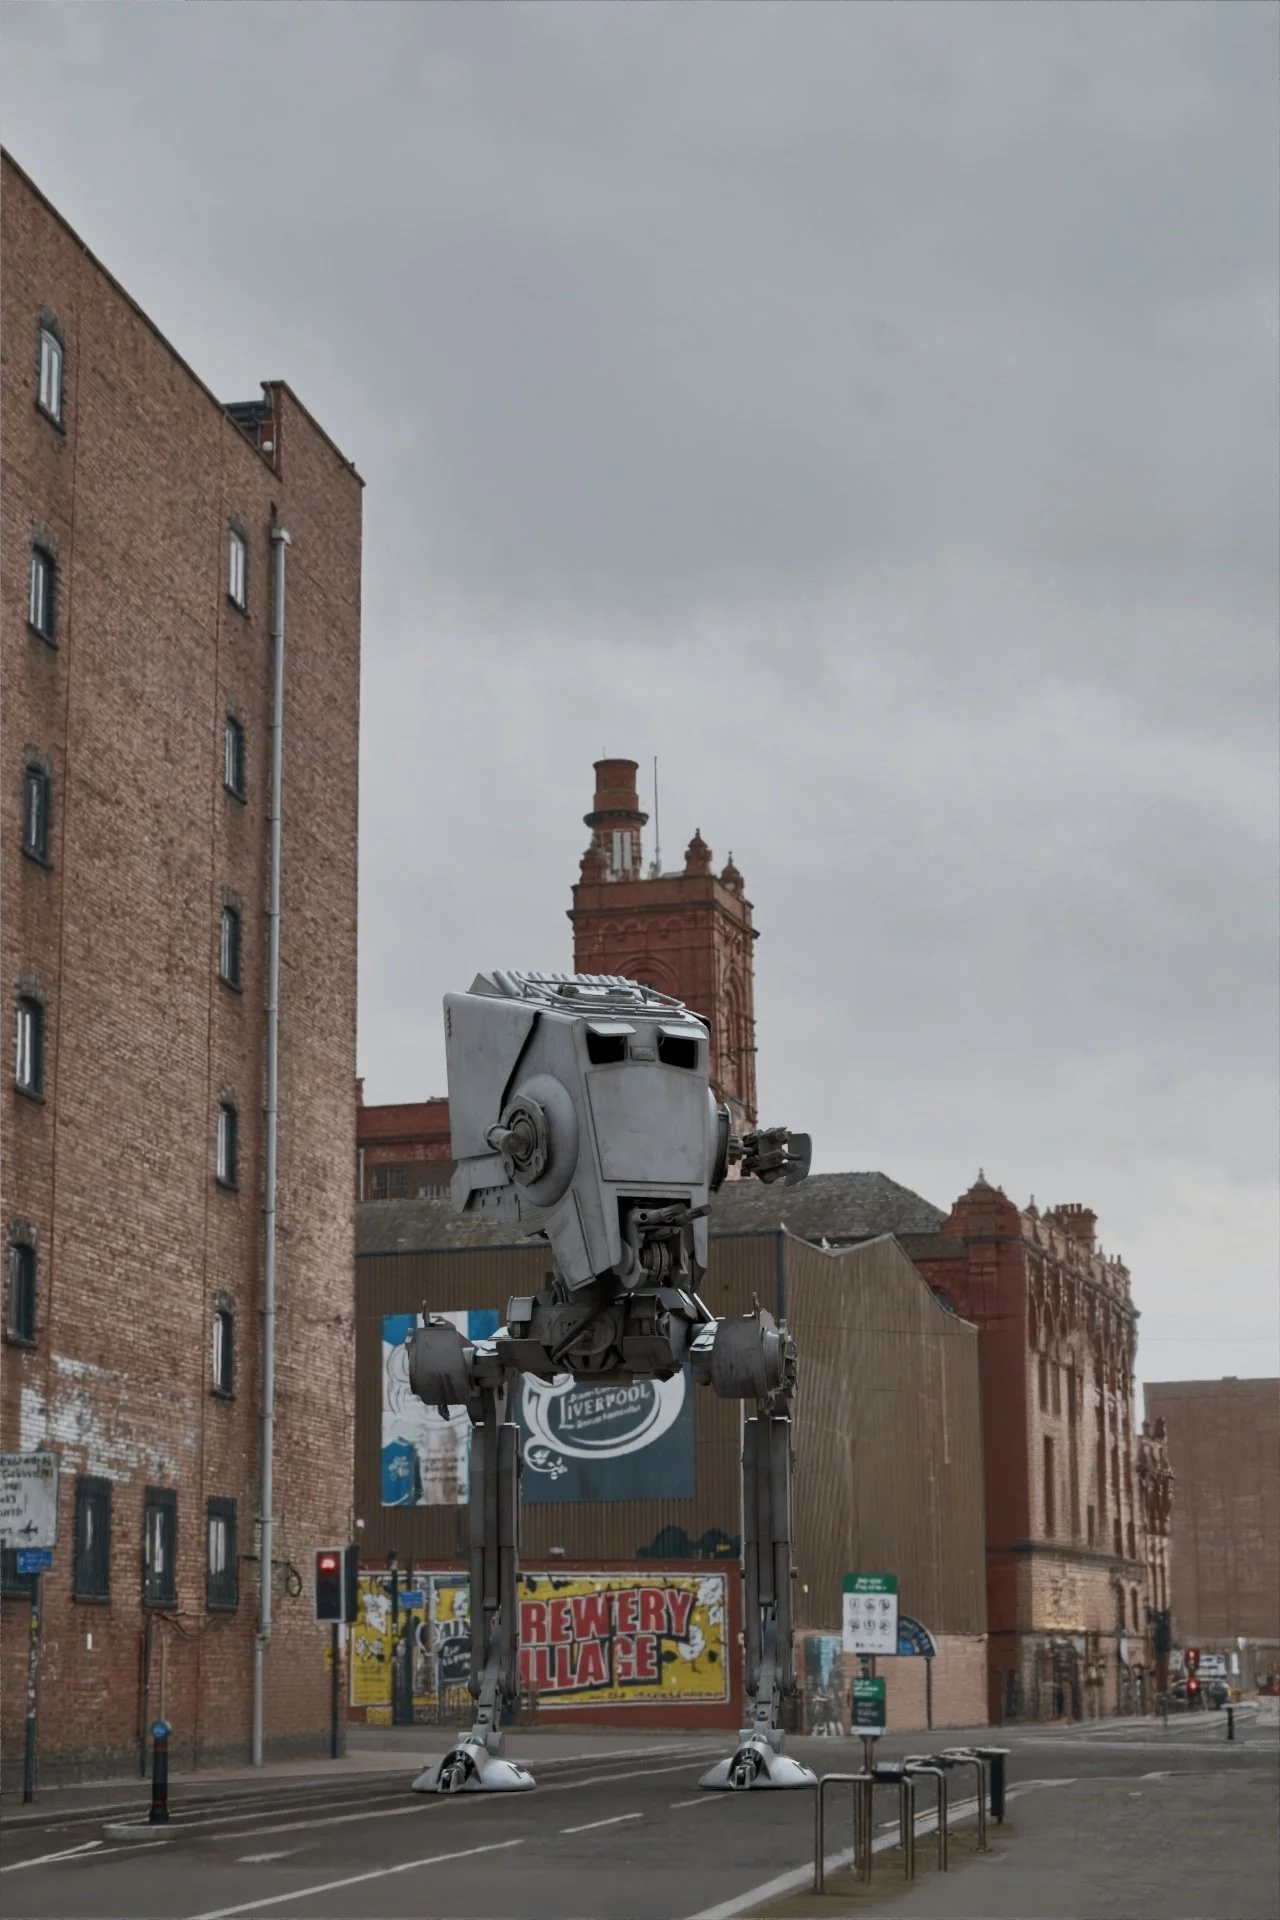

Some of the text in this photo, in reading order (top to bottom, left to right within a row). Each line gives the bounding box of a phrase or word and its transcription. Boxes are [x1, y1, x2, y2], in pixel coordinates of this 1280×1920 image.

[558, 1383, 651, 1430] LIVERPOOL
[519, 1587, 694, 1646] REWERY
[519, 1633, 659, 1693] ILLAGE
